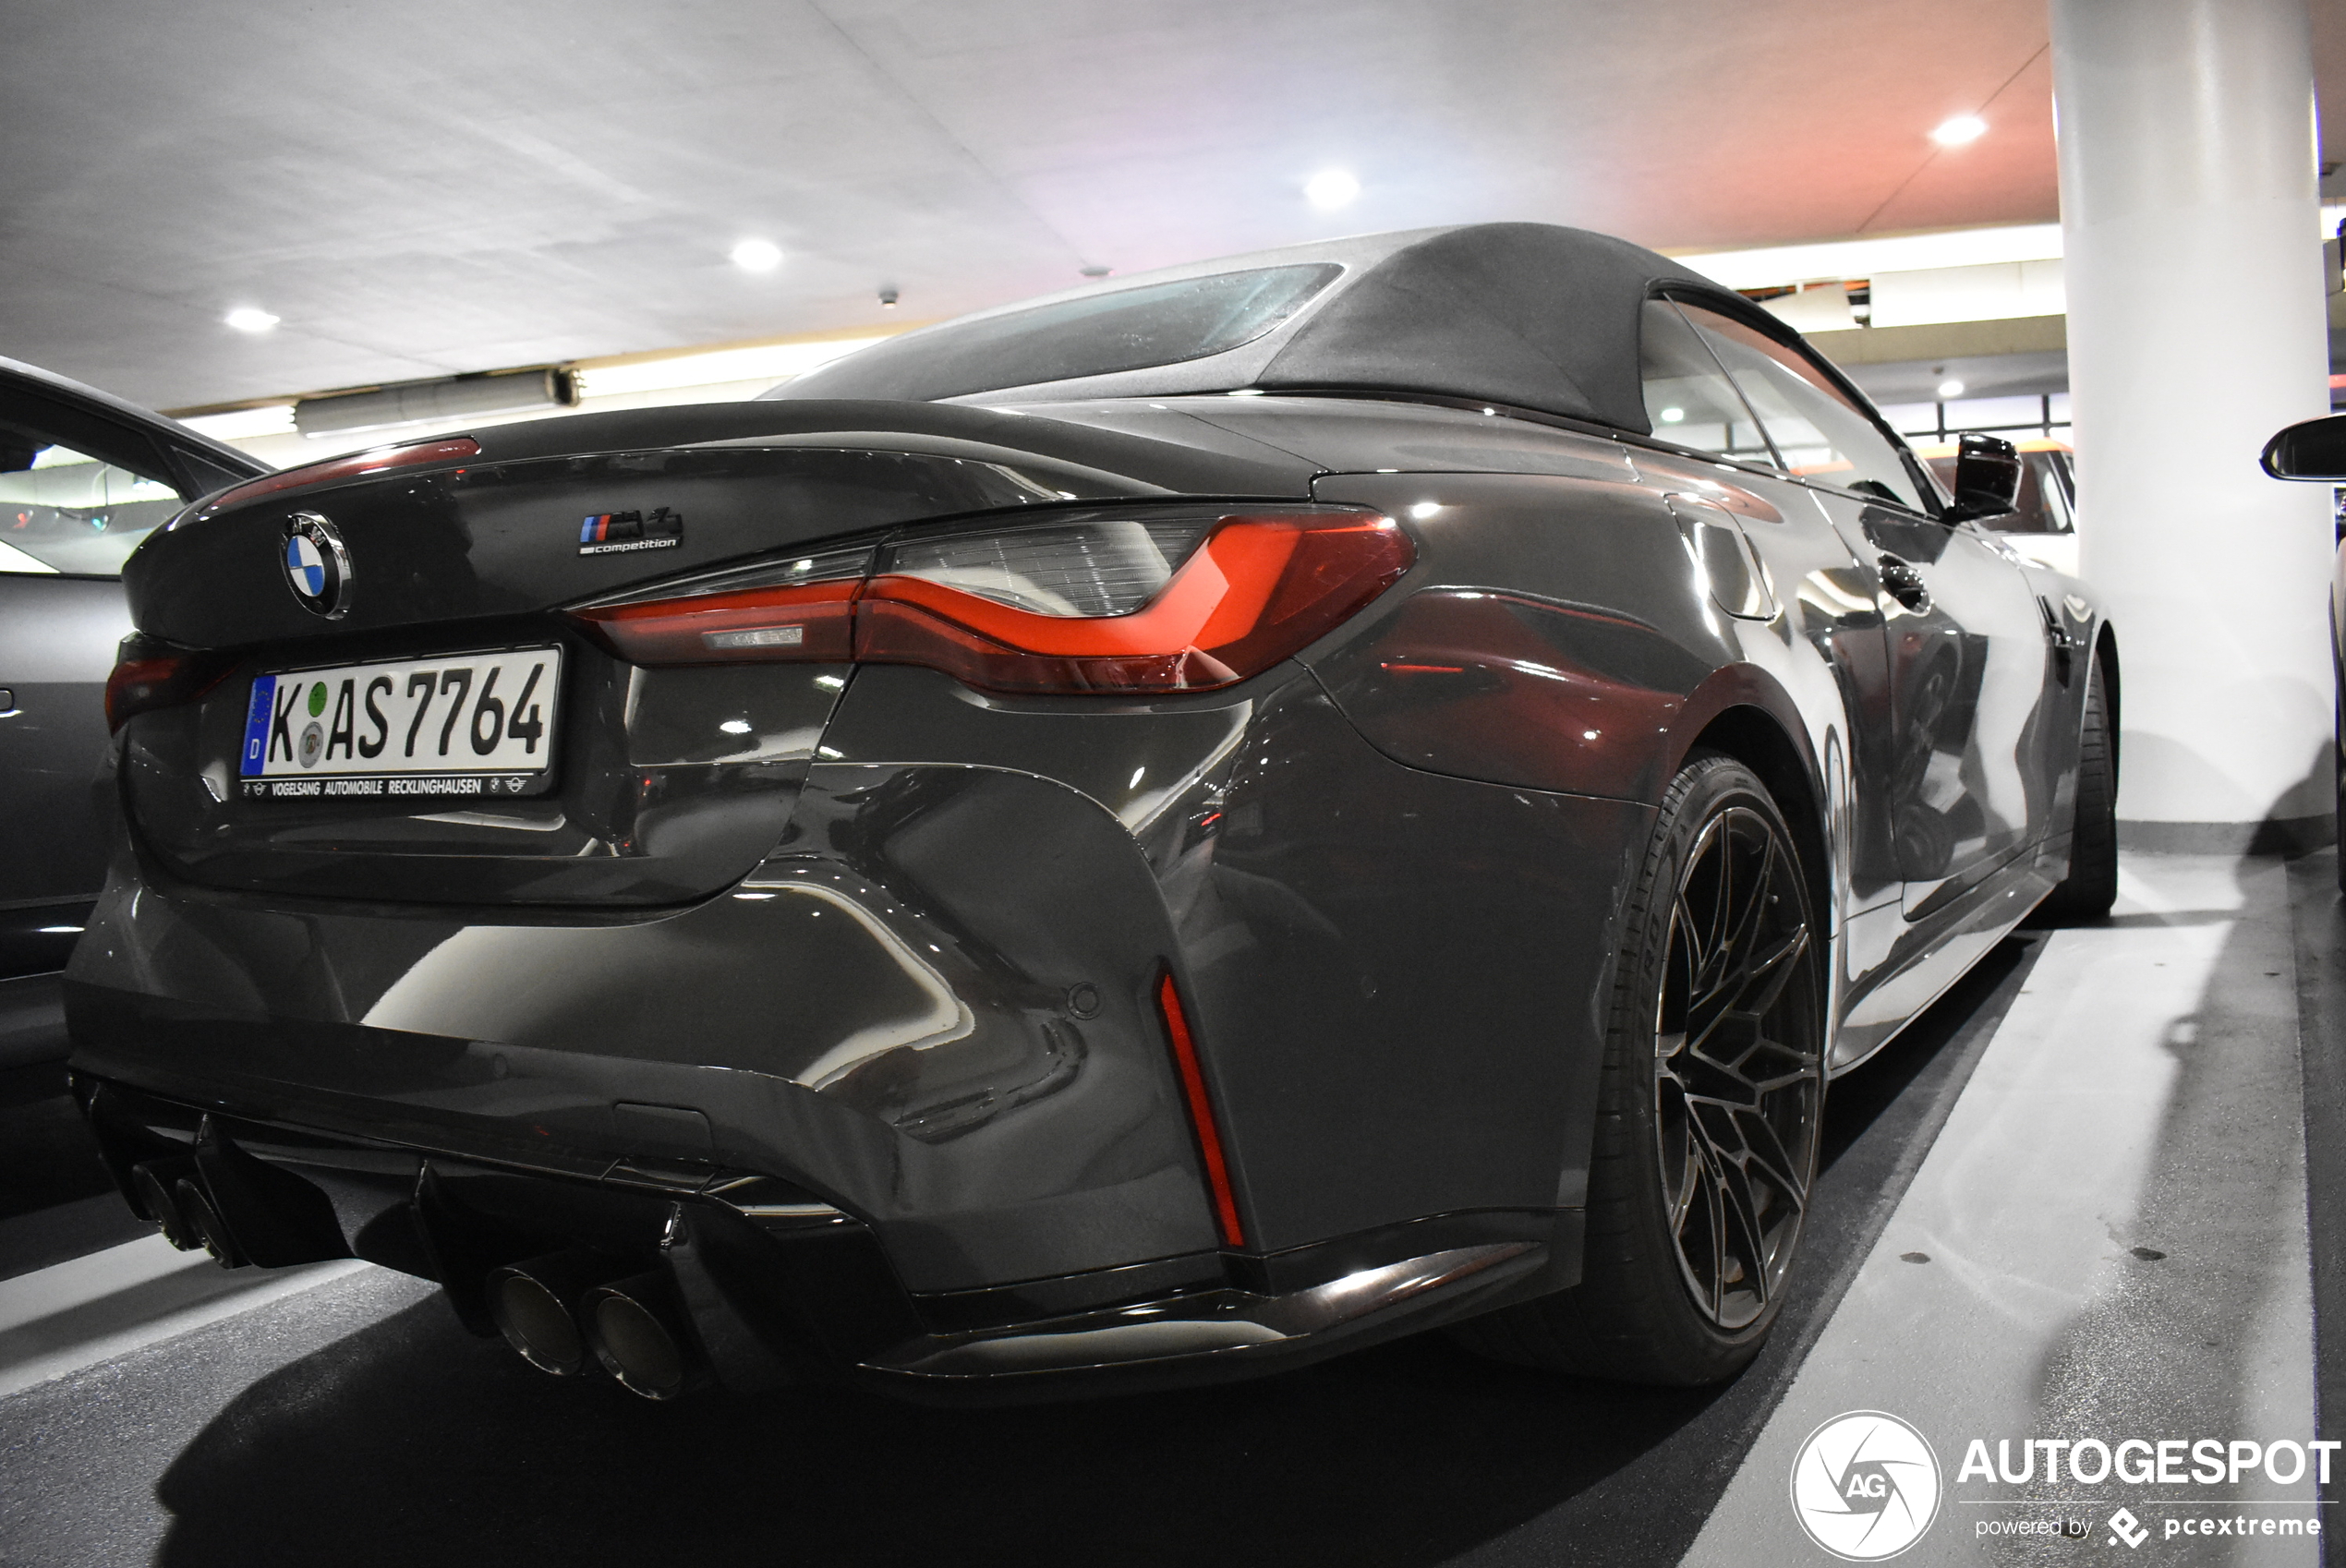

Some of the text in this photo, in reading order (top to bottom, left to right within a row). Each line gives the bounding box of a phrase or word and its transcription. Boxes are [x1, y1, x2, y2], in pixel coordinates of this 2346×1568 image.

[595, 538, 676, 553] competition
[249, 738, 260, 759] D
[272, 778, 481, 796] VOGELSANG AUTOMOBILE RECKLINGHAUSEN
